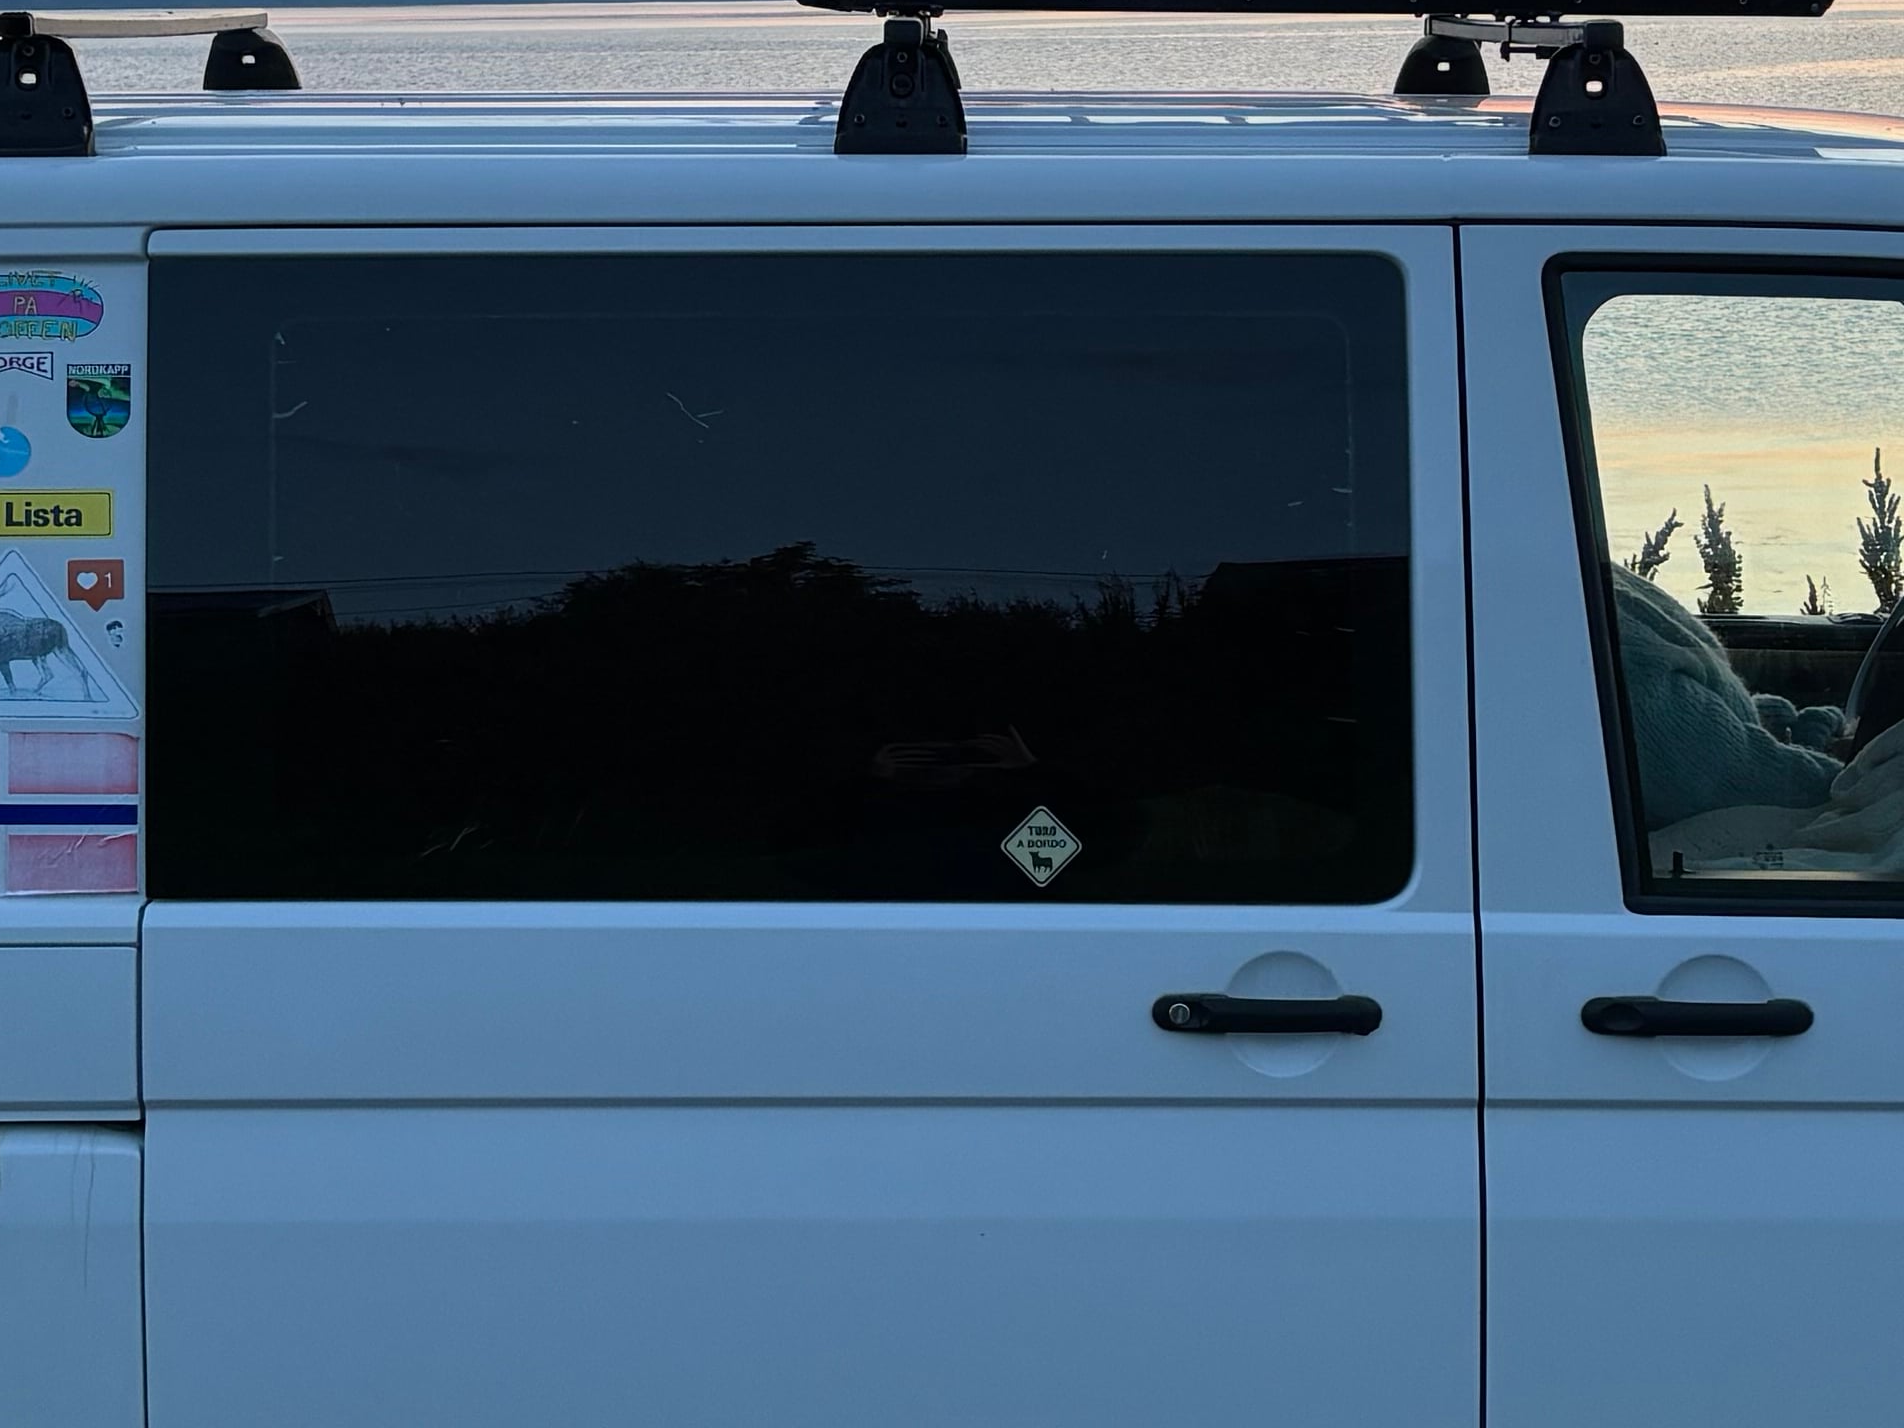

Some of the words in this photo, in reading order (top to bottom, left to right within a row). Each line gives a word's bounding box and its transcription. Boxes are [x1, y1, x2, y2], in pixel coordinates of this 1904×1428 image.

[68, 364, 129, 376] NORDKAPP
[5, 501, 83, 528] Lista
[104, 572, 113, 589] 1
[1016, 839, 1025, 848] A
